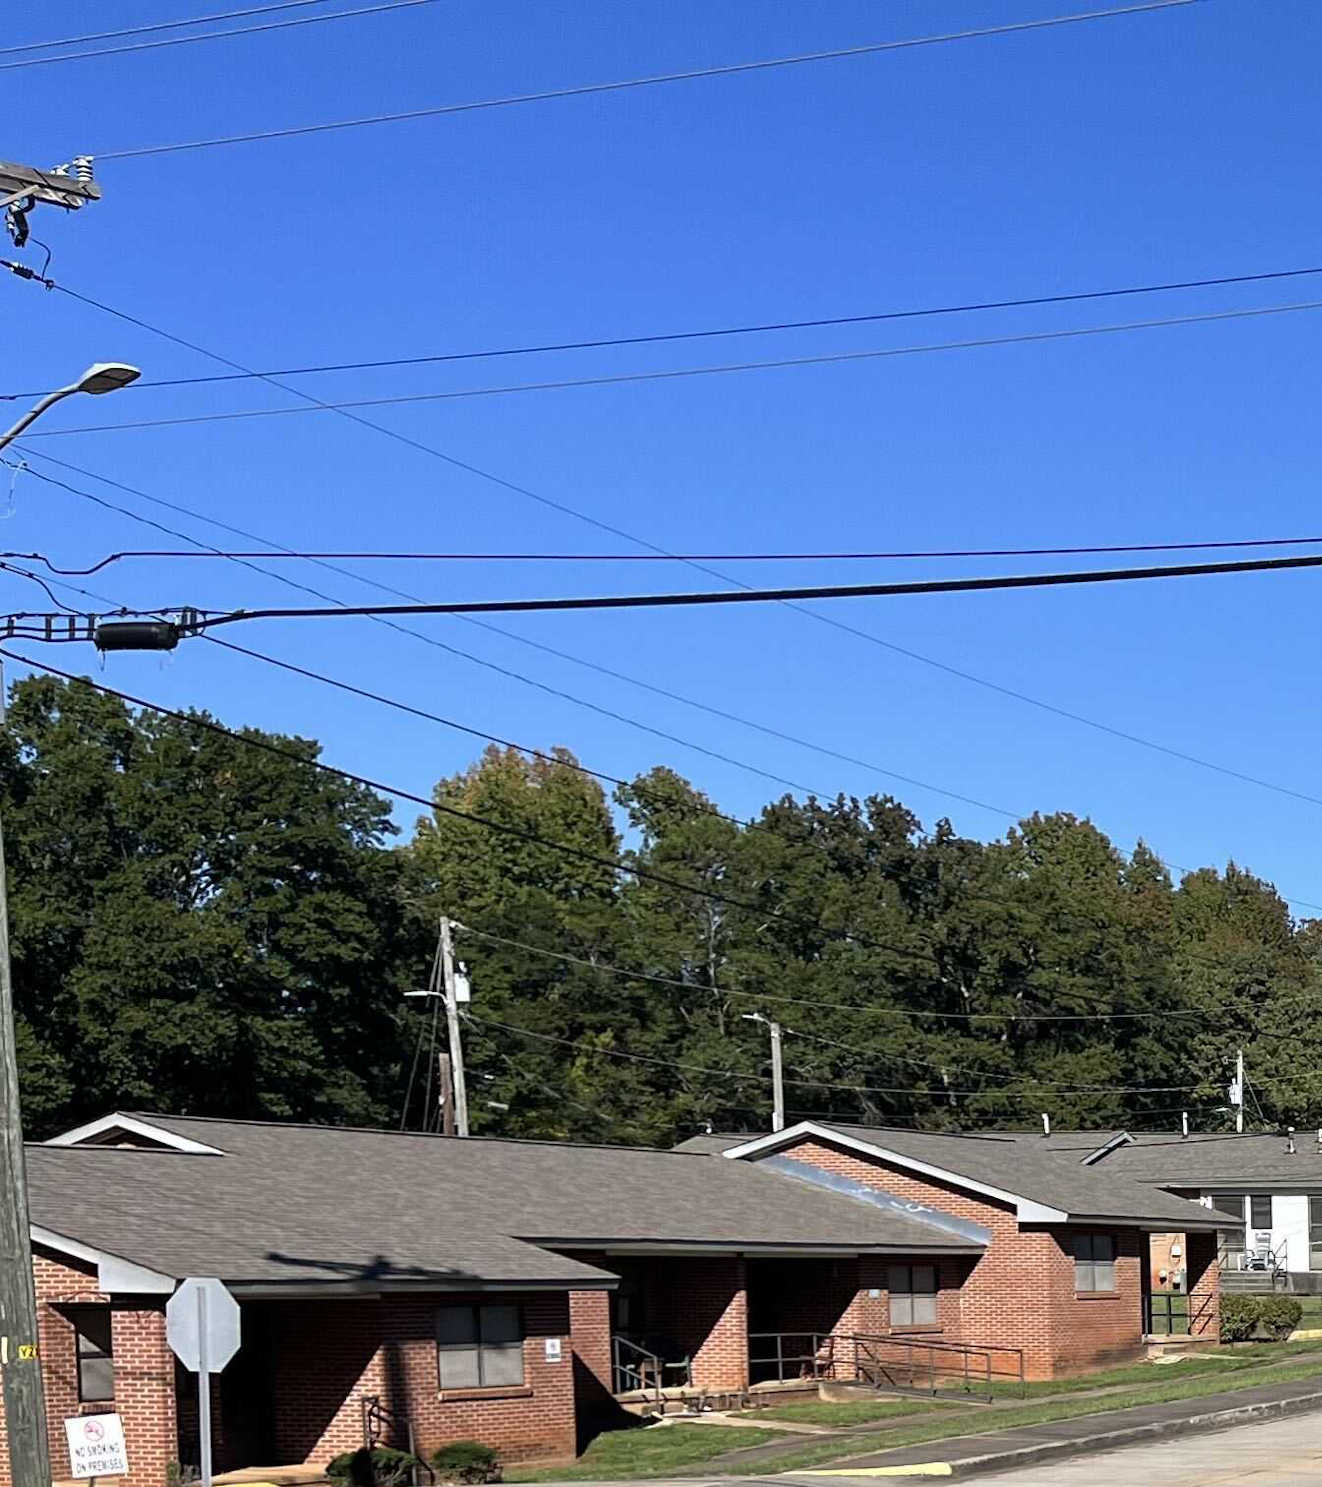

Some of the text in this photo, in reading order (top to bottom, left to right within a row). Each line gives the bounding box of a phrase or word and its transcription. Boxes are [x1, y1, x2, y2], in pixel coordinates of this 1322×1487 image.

[75, 1442, 120, 1457] NO SMOKING
[76, 1457, 123, 1473] ON PREMISES
